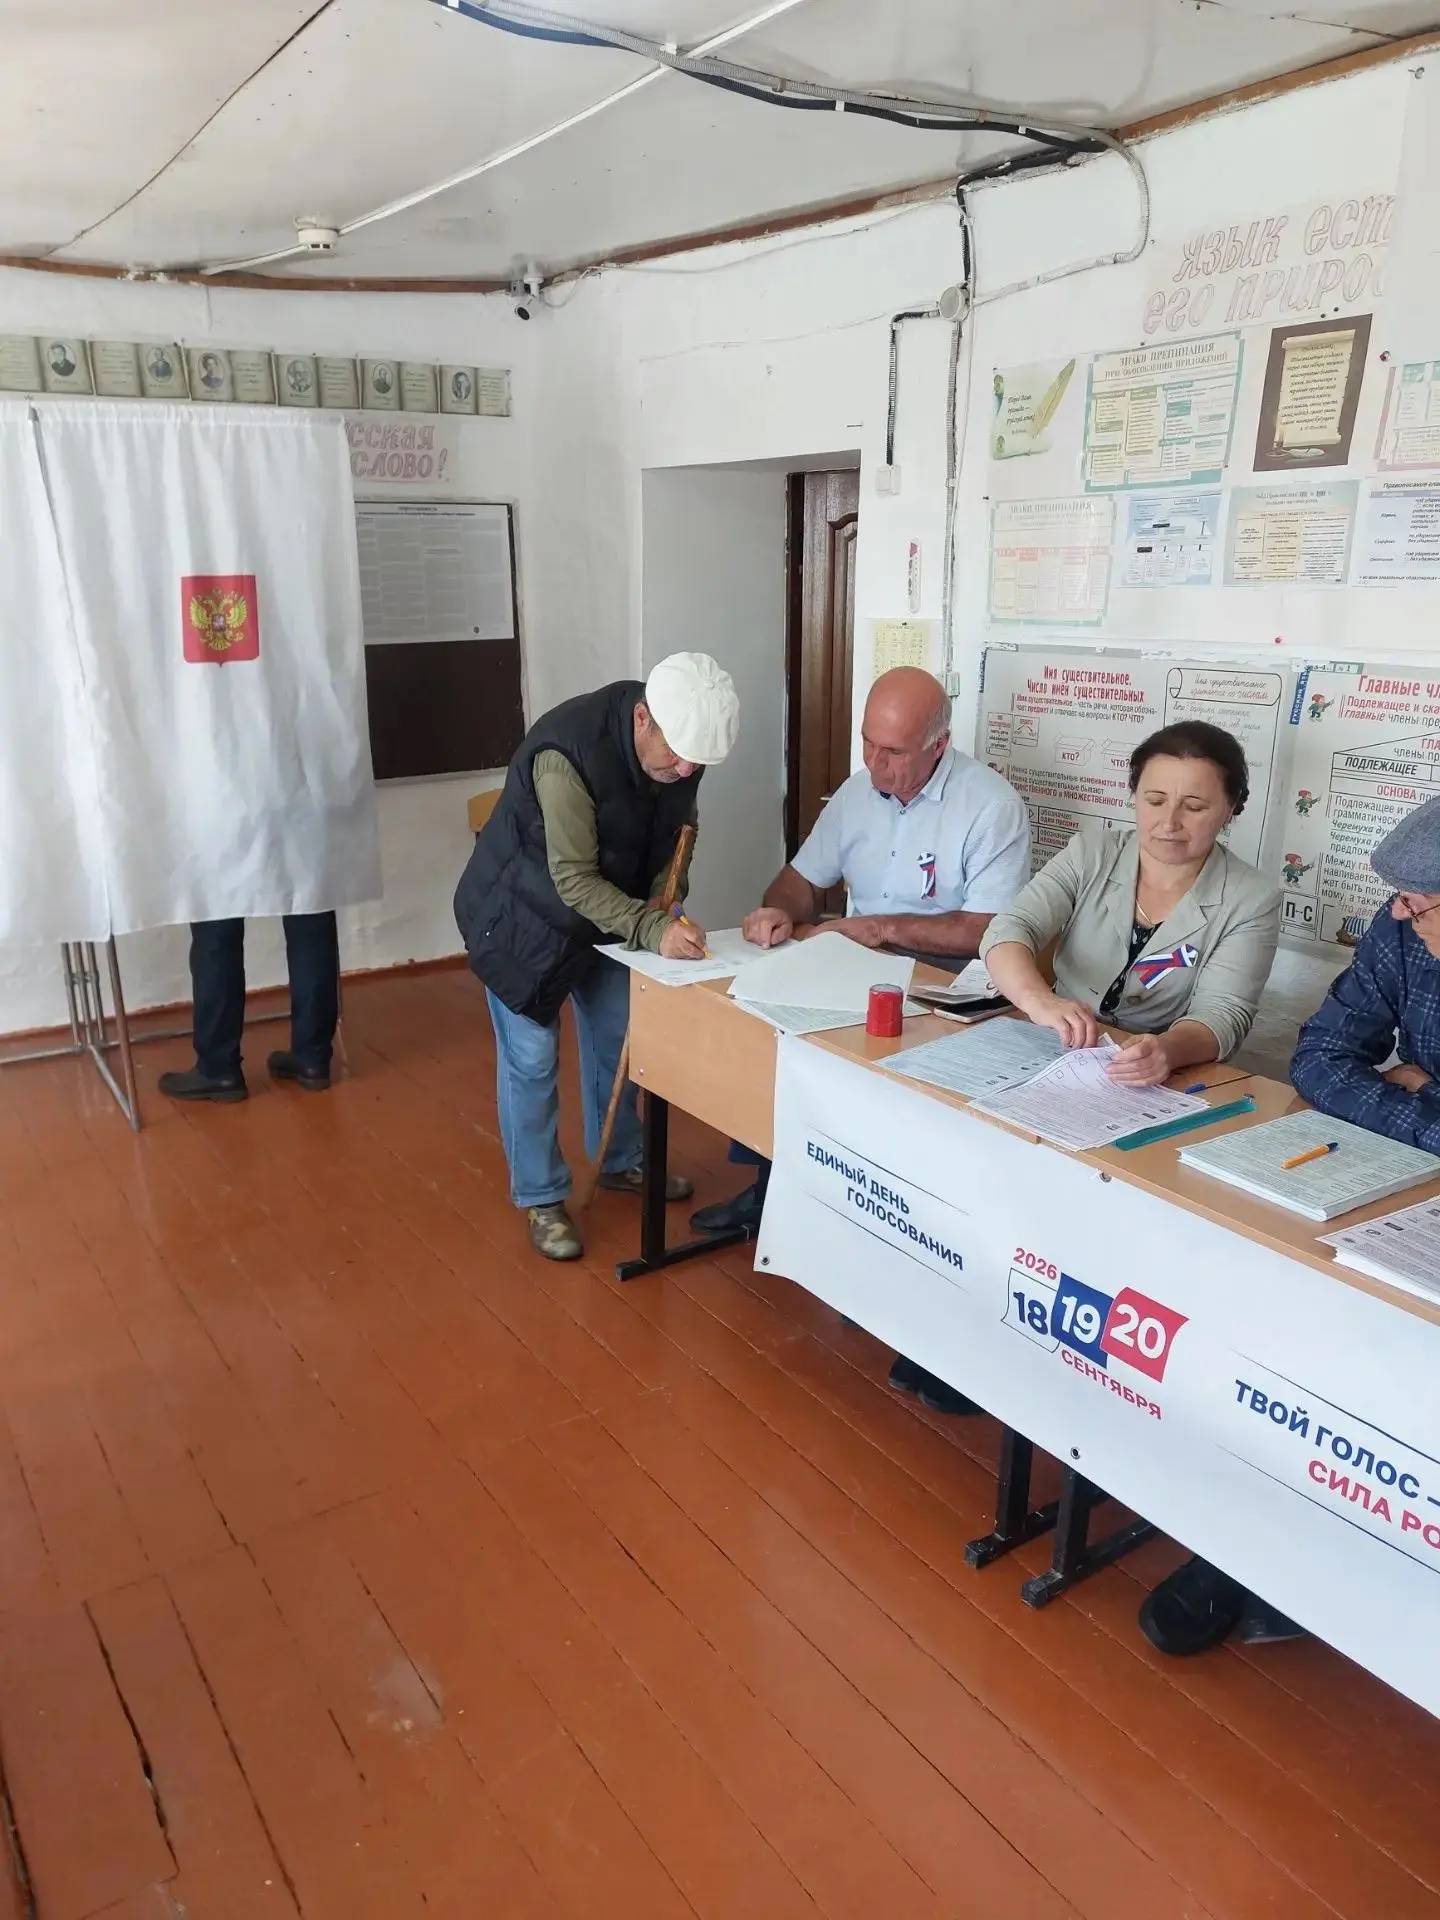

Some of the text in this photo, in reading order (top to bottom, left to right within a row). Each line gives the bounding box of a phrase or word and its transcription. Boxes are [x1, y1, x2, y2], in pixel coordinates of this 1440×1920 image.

[1150, 342, 1215, 361] ПРЕПИНАНИЯ
[1044, 665, 1058, 679] Имя
[1074, 685, 1144, 703] существительных
[1358, 674, 1420, 697] Главные
[1110, 704, 1134, 713] которая
[1347, 695, 1410, 713] Подлежащее
[1345, 709, 1385, 722] главные
[1388, 713, 1419, 725] члены
[1394, 747, 1424, 760] члены
[1345, 756, 1419, 776] ПОДЛЕЖАЩЕЕ
[1064, 791, 1123, 807] МНОЖЕСТВЕННОГО
[1376, 784, 1417, 800] ОСНОВА
[1335, 795, 1395, 814] Подлежащее
[1397, 806, 1403, 814] и
[1332, 819, 1374, 833] Черемуха
[1330, 831, 1372, 846] Черемуха
[1325, 854, 1356, 870] Между
[1322, 877, 1339, 887] жет
[1341, 879, 1363, 893] быть
[1324, 867, 1380, 885] навливается
[1349, 894, 1355, 902] а
[807, 1141, 910, 1215] ЕДИНЫЙ ДЕНЬ
[847, 1186, 964, 1271] ГОЛОСОВАНИЯ
[1013, 1247, 1058, 1281] 2026
[1013, 1291, 1167, 1360] 18 19 20
[1061, 1348, 1162, 1421] СЕНТЯБРЯ
[1235, 1378, 1310, 1439] ТВОЙ
[1314, 1425, 1420, 1499] ГОЛОС
[1308, 1459, 1392, 1524] СИЛА
